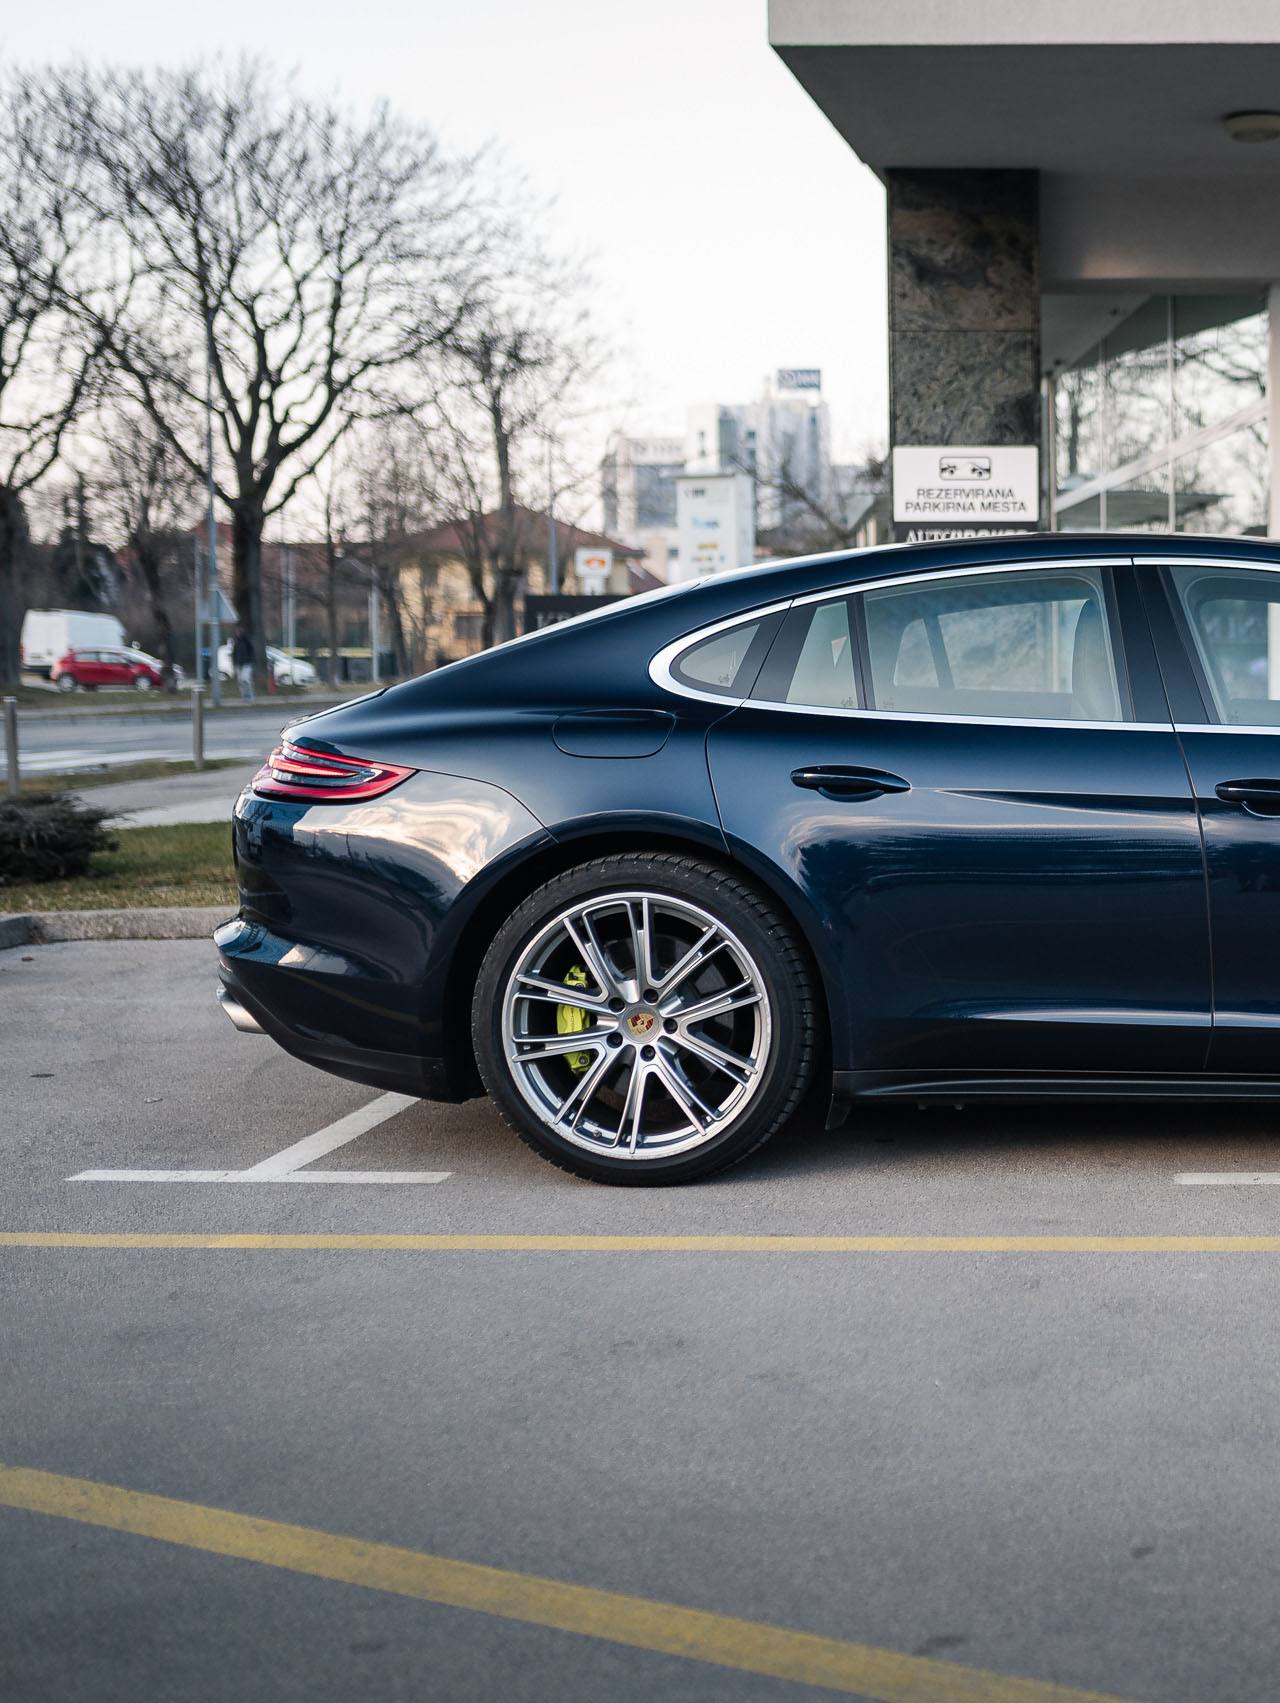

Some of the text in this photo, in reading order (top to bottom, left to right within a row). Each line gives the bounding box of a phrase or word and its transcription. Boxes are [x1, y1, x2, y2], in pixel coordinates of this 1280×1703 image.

[916, 488, 1016, 499] REZERVIRANA
[904, 501, 1026, 512] PARKIRNA MESTA
